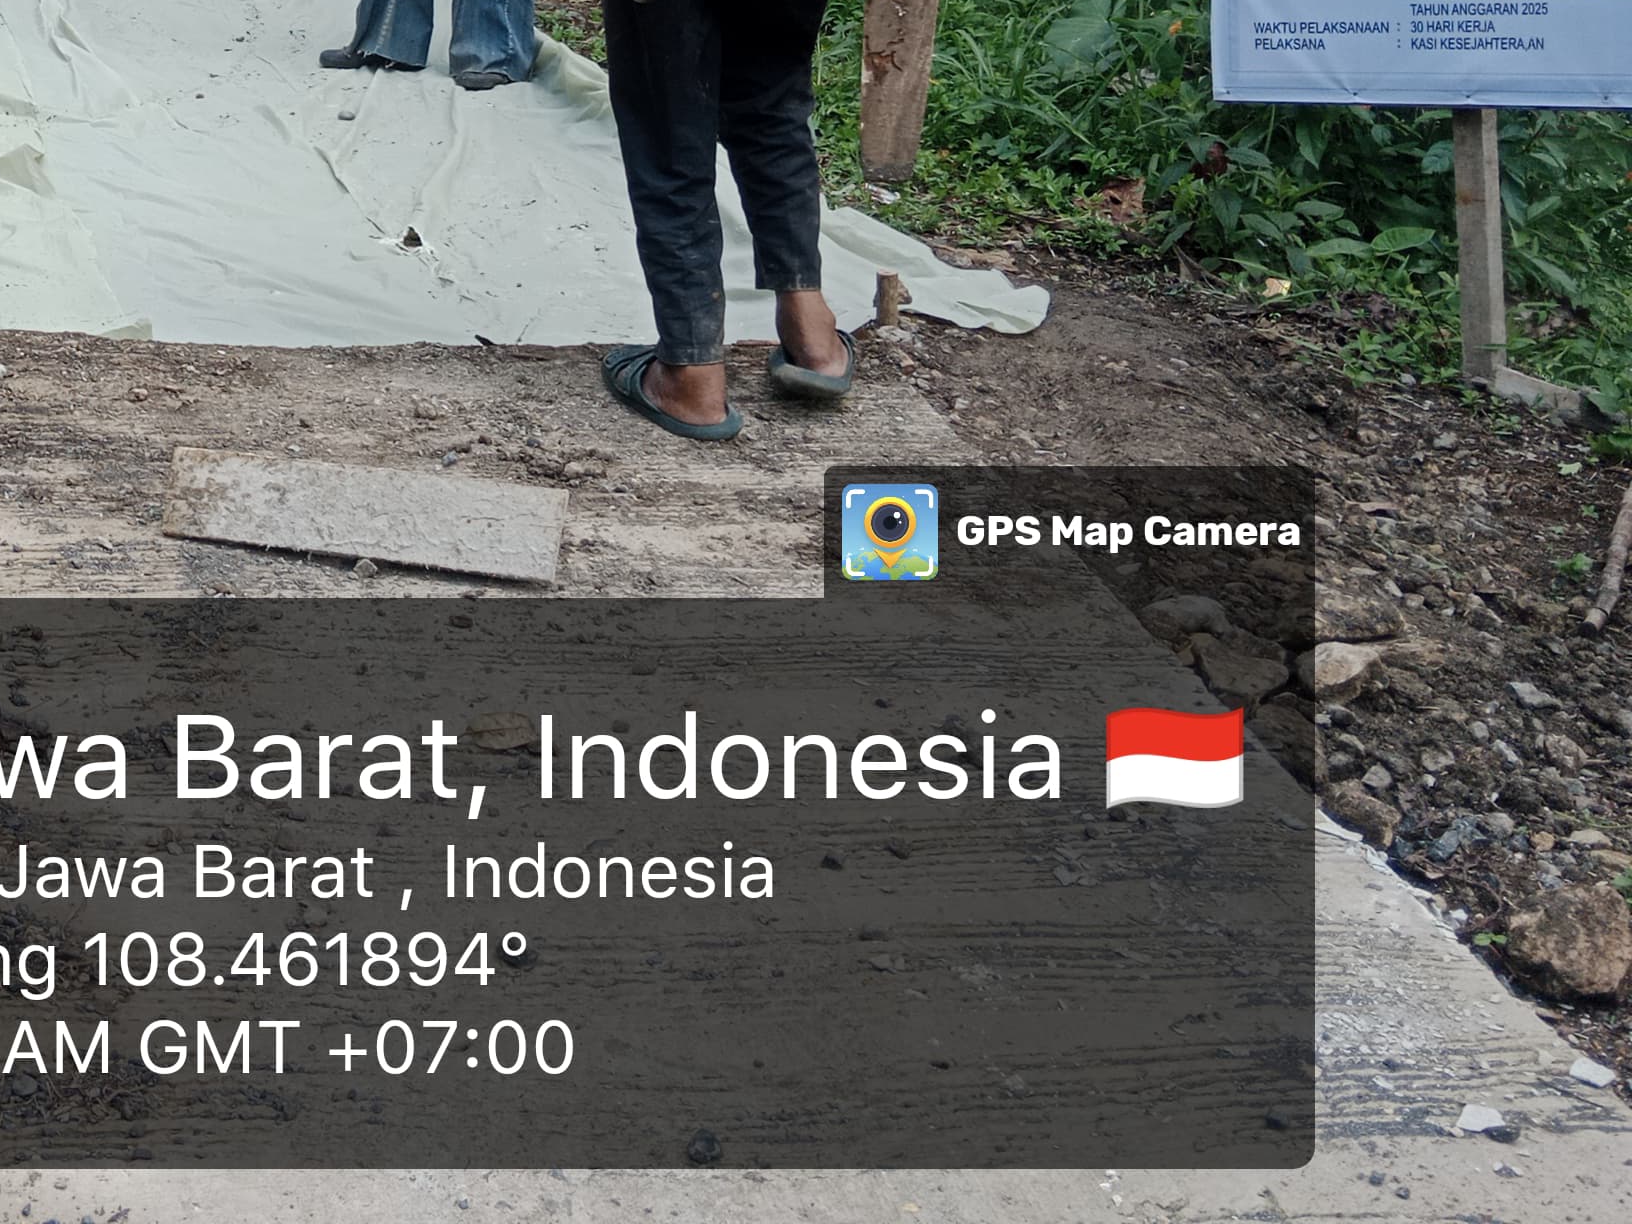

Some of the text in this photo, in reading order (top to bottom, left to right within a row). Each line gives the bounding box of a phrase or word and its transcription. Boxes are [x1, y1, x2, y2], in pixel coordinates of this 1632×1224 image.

[1410, 2, 1549, 16] TAHUN ANGGARAN 2025
[1253, 21, 1297, 34] WAKTU
[1299, 21, 1390, 34] PELAKSANAAN
[1410, 20, 1424, 34] 30
[1426, 20, 1454, 33] HARI
[1457, 20, 1496, 33] KERJA
[1255, 37, 1326, 51] PELAKSANA
[1411, 37, 1437, 50] KASI
